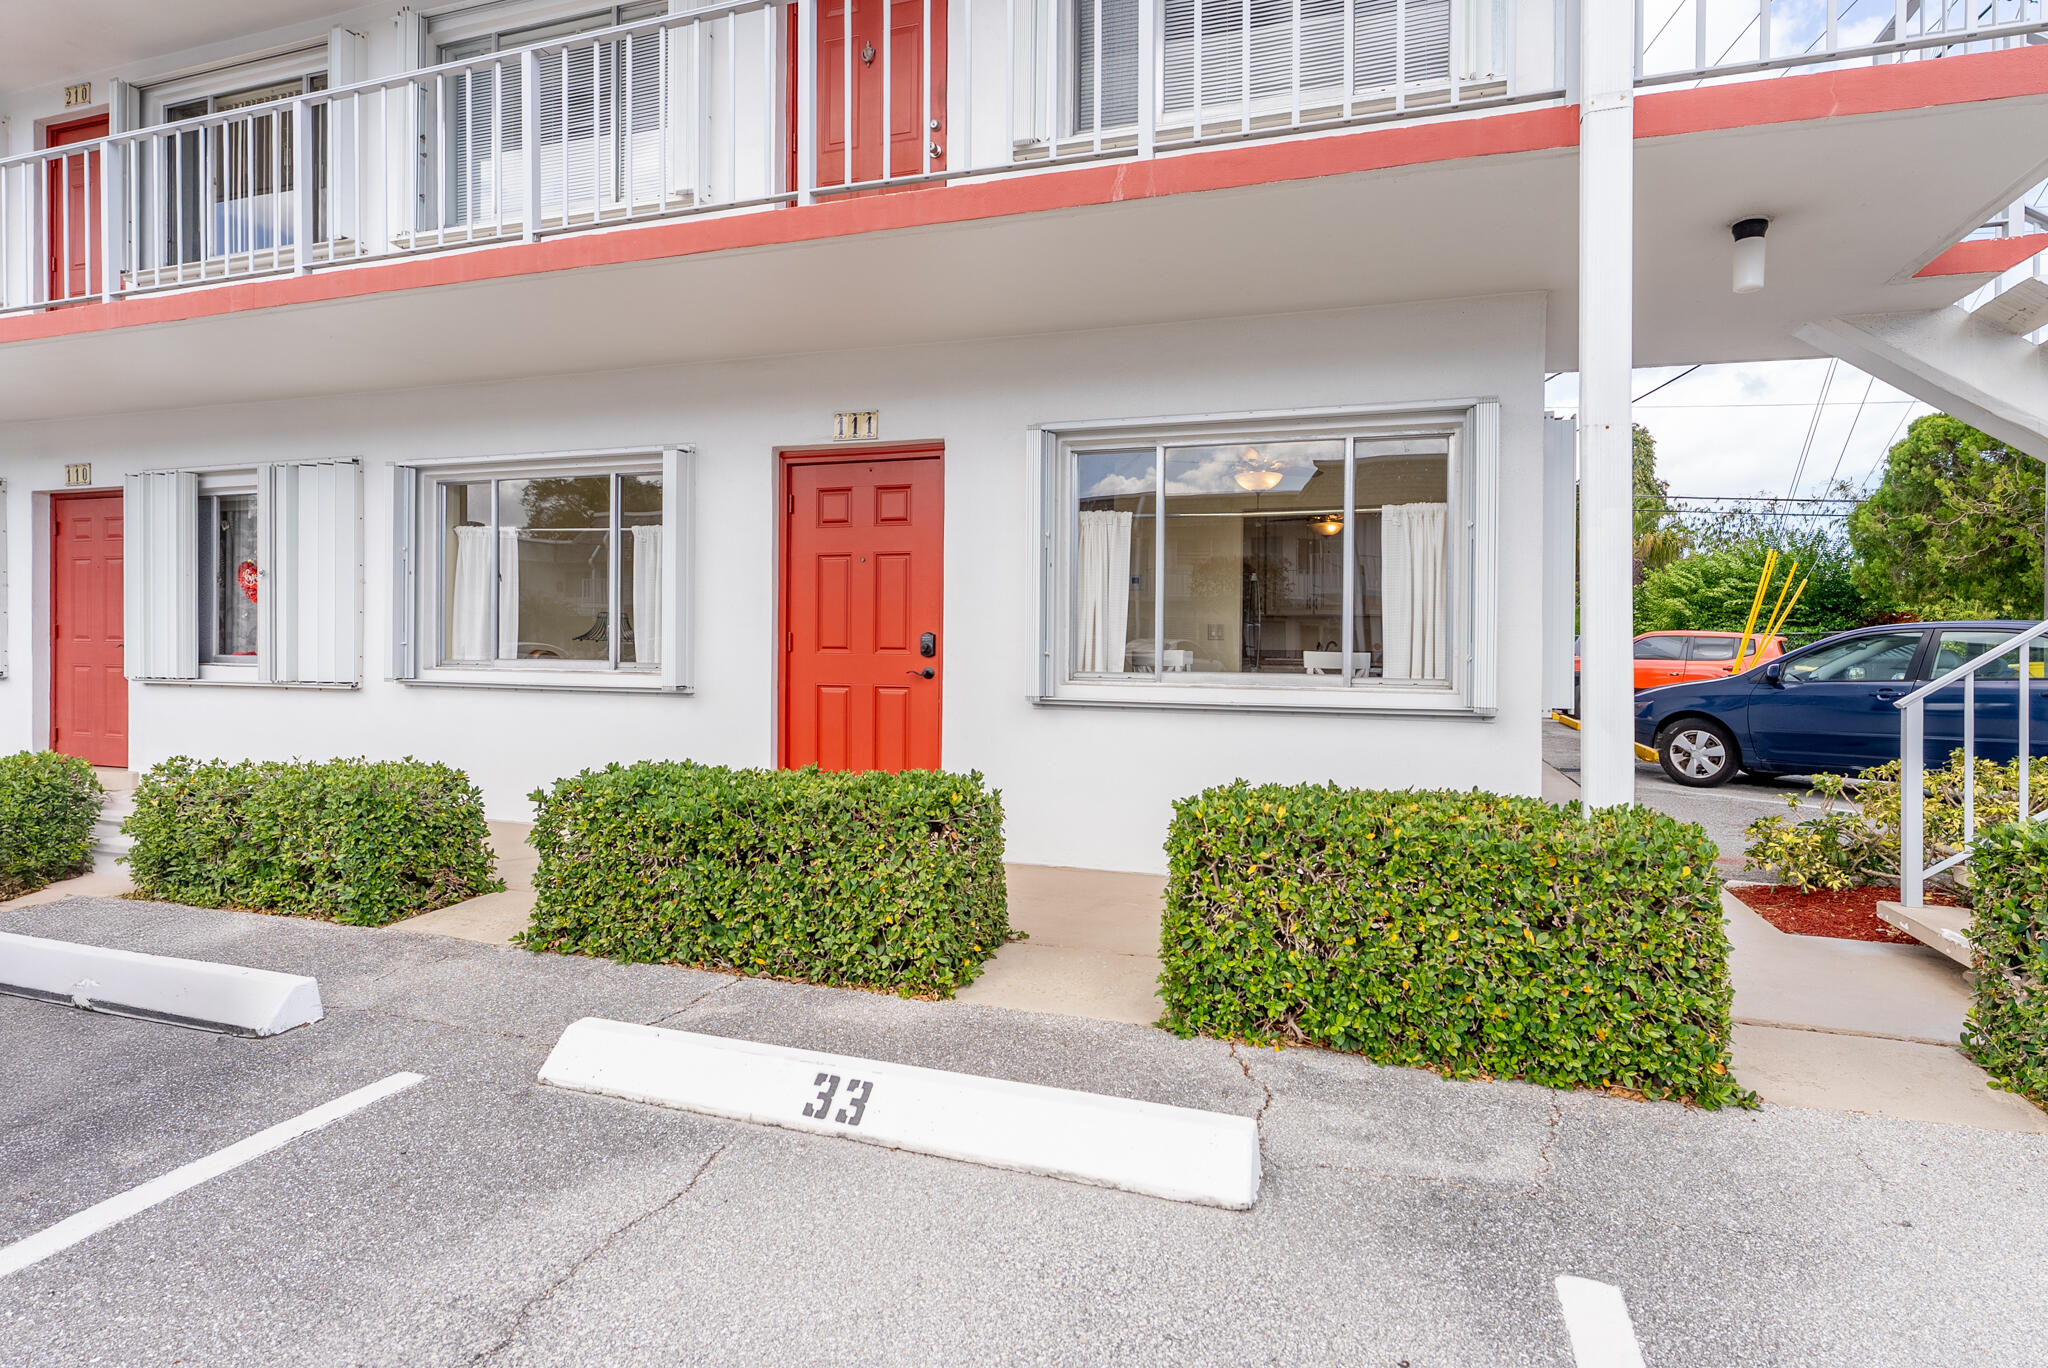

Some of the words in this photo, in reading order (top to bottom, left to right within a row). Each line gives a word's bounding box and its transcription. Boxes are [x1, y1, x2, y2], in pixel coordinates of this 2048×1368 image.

[65, 87, 88, 105] 210
[837, 415, 873, 436] 111
[67, 467, 88, 482] 110
[802, 1072, 874, 1126] 33
